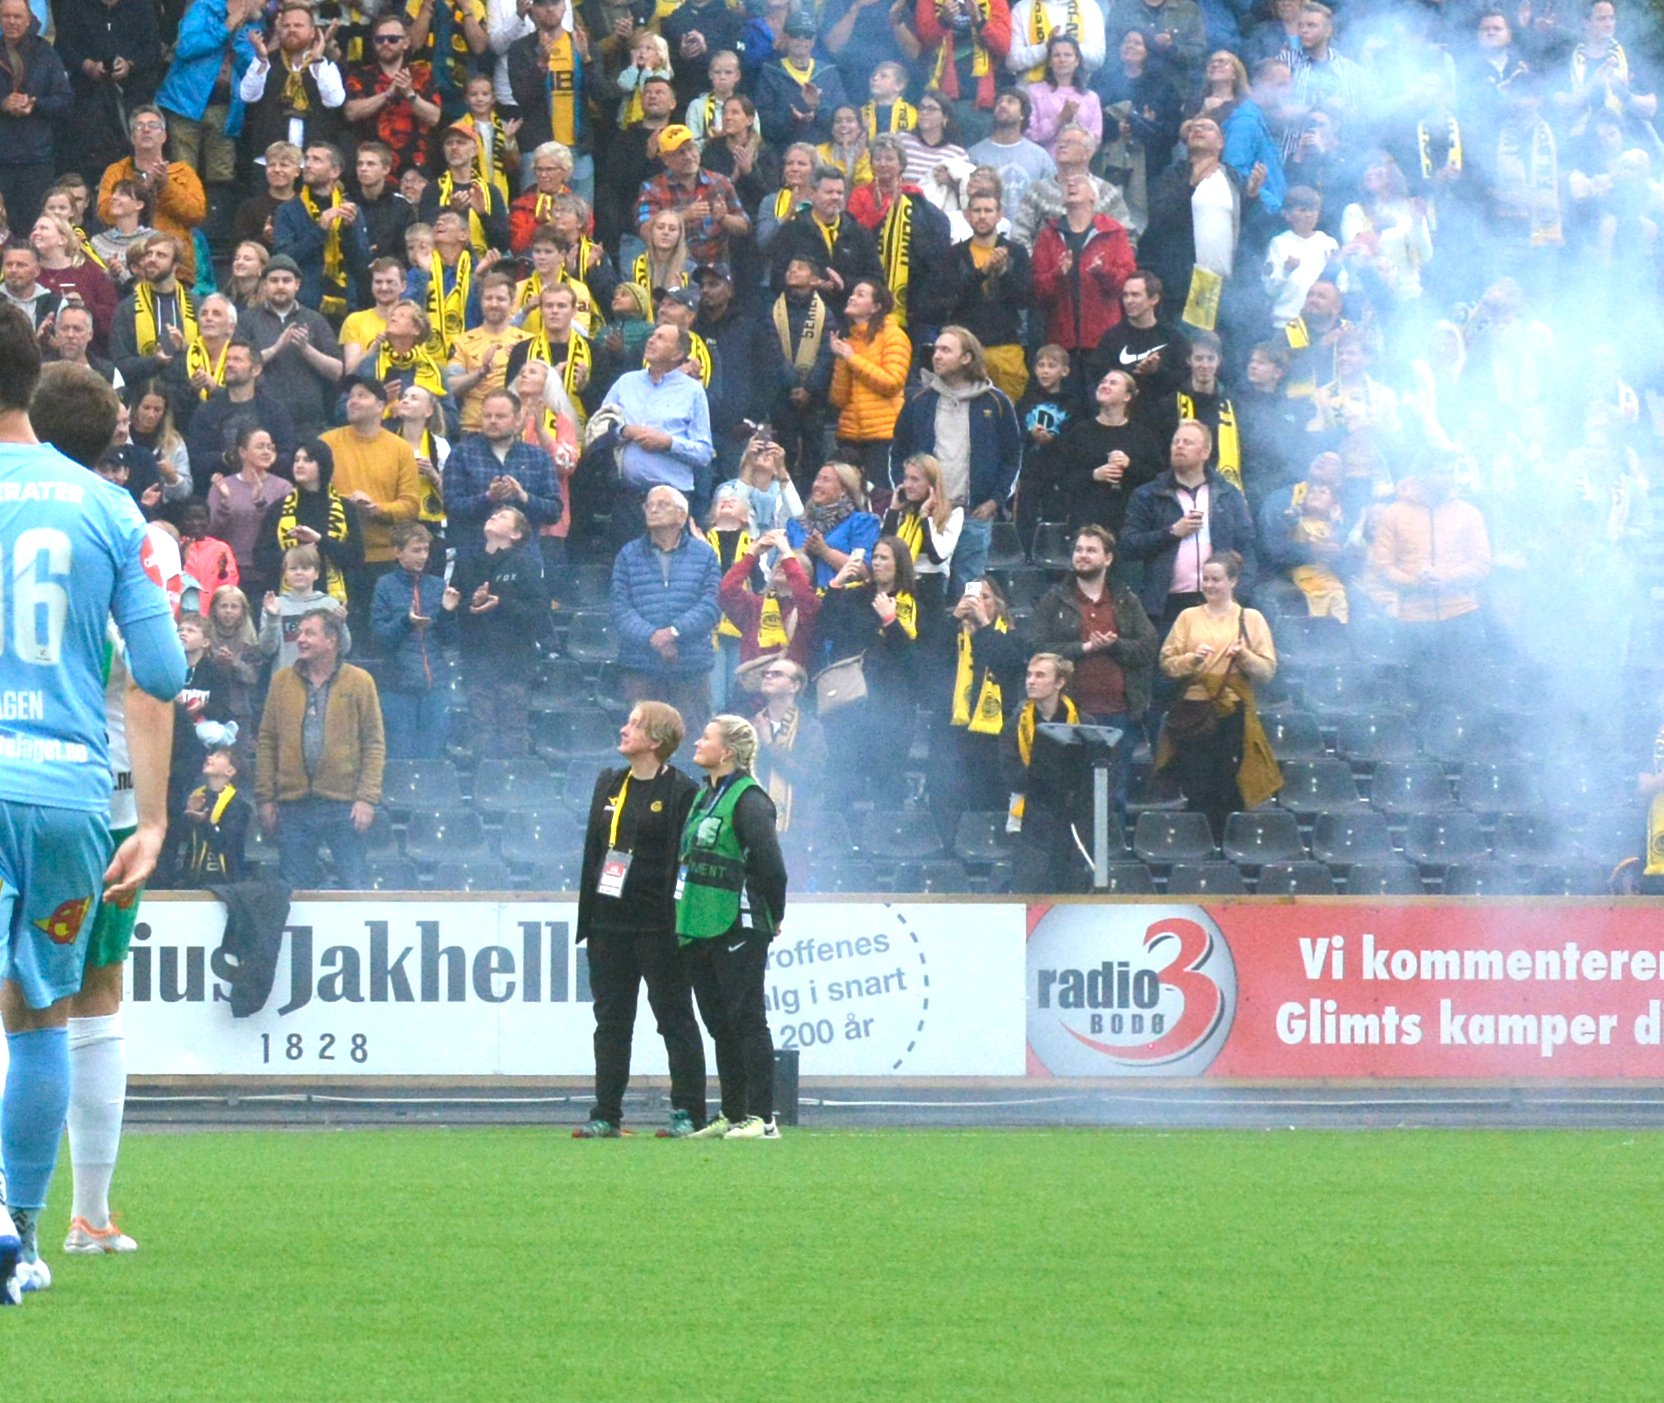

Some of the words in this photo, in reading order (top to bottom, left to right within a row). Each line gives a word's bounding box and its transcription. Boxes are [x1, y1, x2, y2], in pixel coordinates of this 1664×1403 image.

[1299, 936, 1344, 981] Vi
[810, 979, 819, 1005] i
[826, 968, 909, 1001] snart
[1037, 960, 1161, 1010] radio
[779, 1020, 837, 1050] 200
[844, 1012, 877, 1039] år
[1090, 1013, 1165, 1035] BODØ
[1275, 1000, 1423, 1046] Glimts
[1440, 1000, 1617, 1057] kamper
[261, 1032, 369, 1064] 1828
